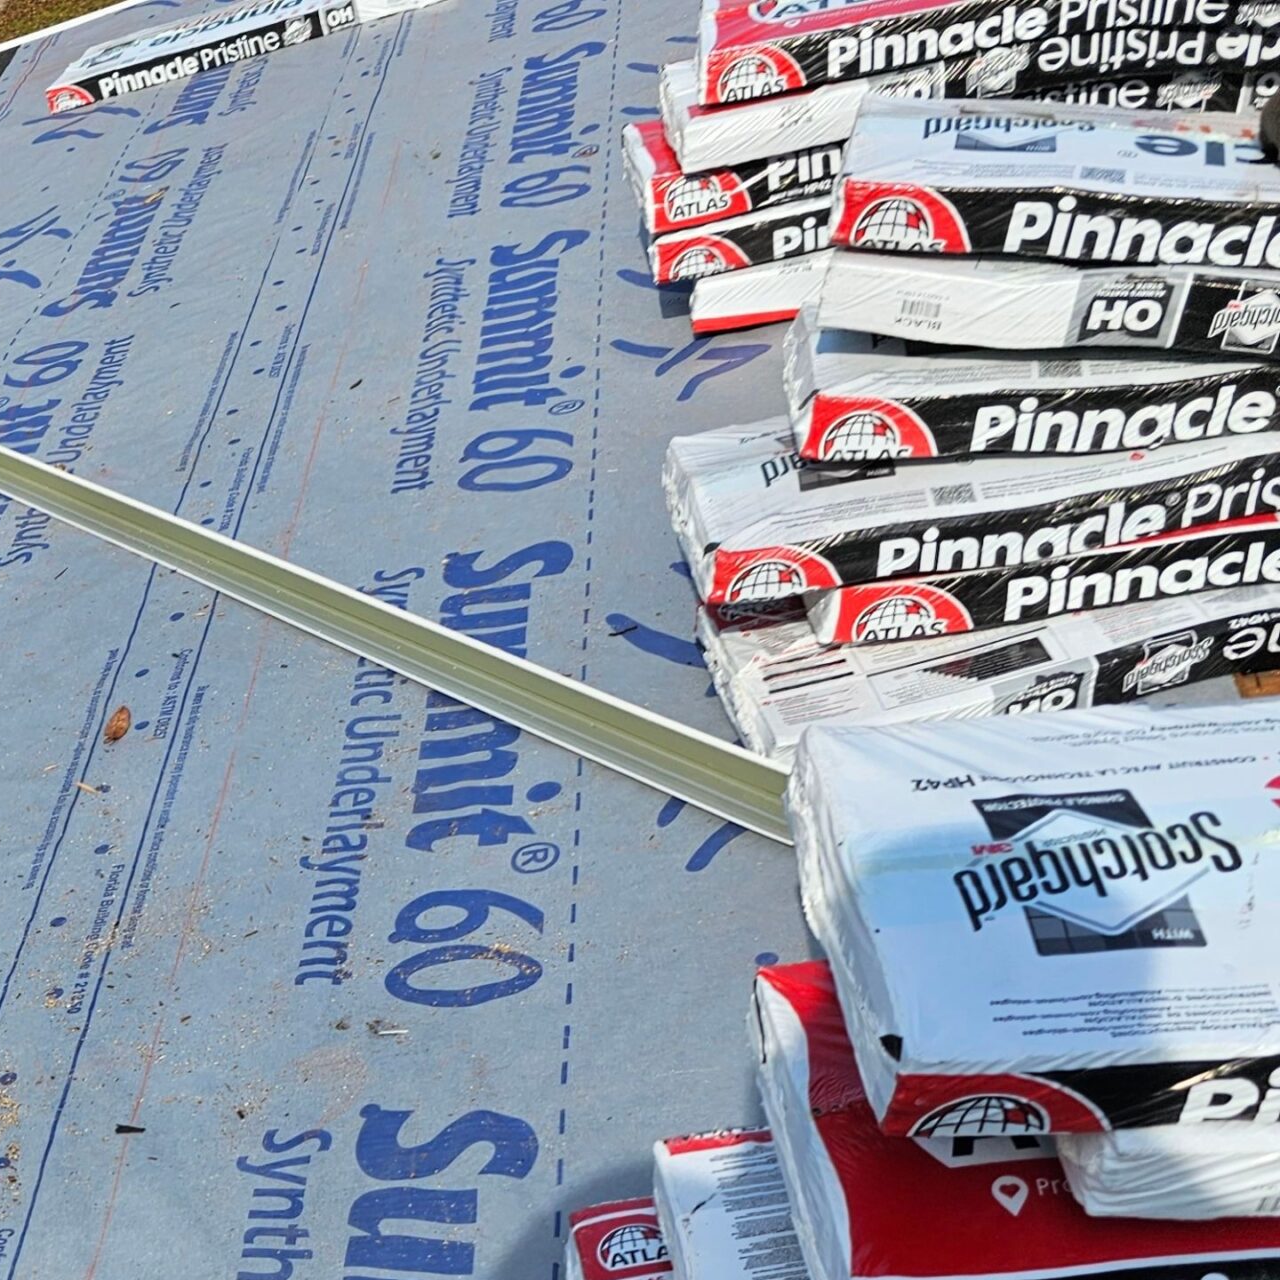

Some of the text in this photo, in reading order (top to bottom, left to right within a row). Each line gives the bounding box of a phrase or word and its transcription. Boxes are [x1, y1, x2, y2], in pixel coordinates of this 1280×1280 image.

[201, 31, 280, 71] Pristine
[827, 5, 1049, 78] Pinnacle
[1037, 28, 1207, 74] Pristine
[468, 66, 513, 126] Synthetic
[725, 78, 785, 102] ATLAS
[118, 147, 190, 183] 60
[159, 142, 229, 231] Underlayment
[445, 121, 502, 218] Underlayment
[499, 165, 592, 208] 60
[672, 193, 730, 220] ATLAS
[1085, 298, 1164, 334] OH
[2, 340, 90, 389] 60
[390, 257, 477, 495] Synthetic Underlayment
[46, 334, 135, 475] Underlayment
[970, 384, 1277, 453] Pinnacle
[457, 428, 574, 492] 60
[862, 620, 946, 641] ATLAS
[911, 774, 975, 792] HP42
[294, 714, 400, 987] Underlayment
[953, 811, 1243, 931] Scotchgard
[102, 863, 126, 902] Florida
[384, 889, 544, 1008] 60
